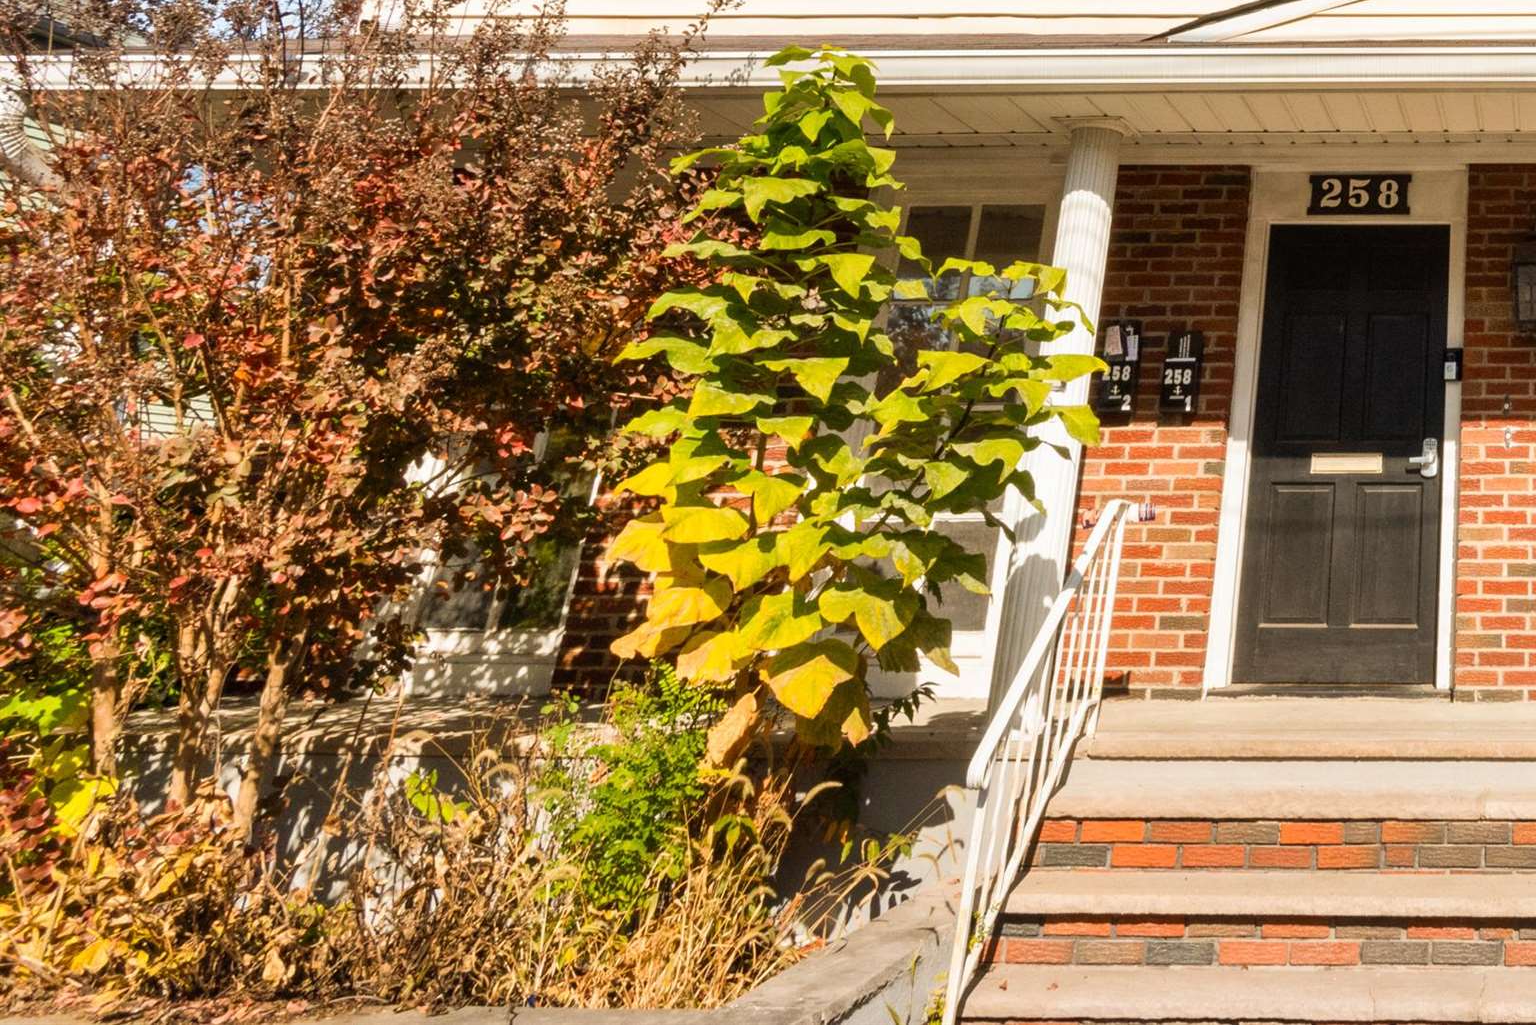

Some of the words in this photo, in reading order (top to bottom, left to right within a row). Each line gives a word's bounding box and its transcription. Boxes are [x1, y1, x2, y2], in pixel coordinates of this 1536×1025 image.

[1321, 178, 1399, 208] 258
[1164, 369, 1192, 384] 258
[1121, 395, 1131, 411] 2
[1185, 396, 1192, 411] 1
